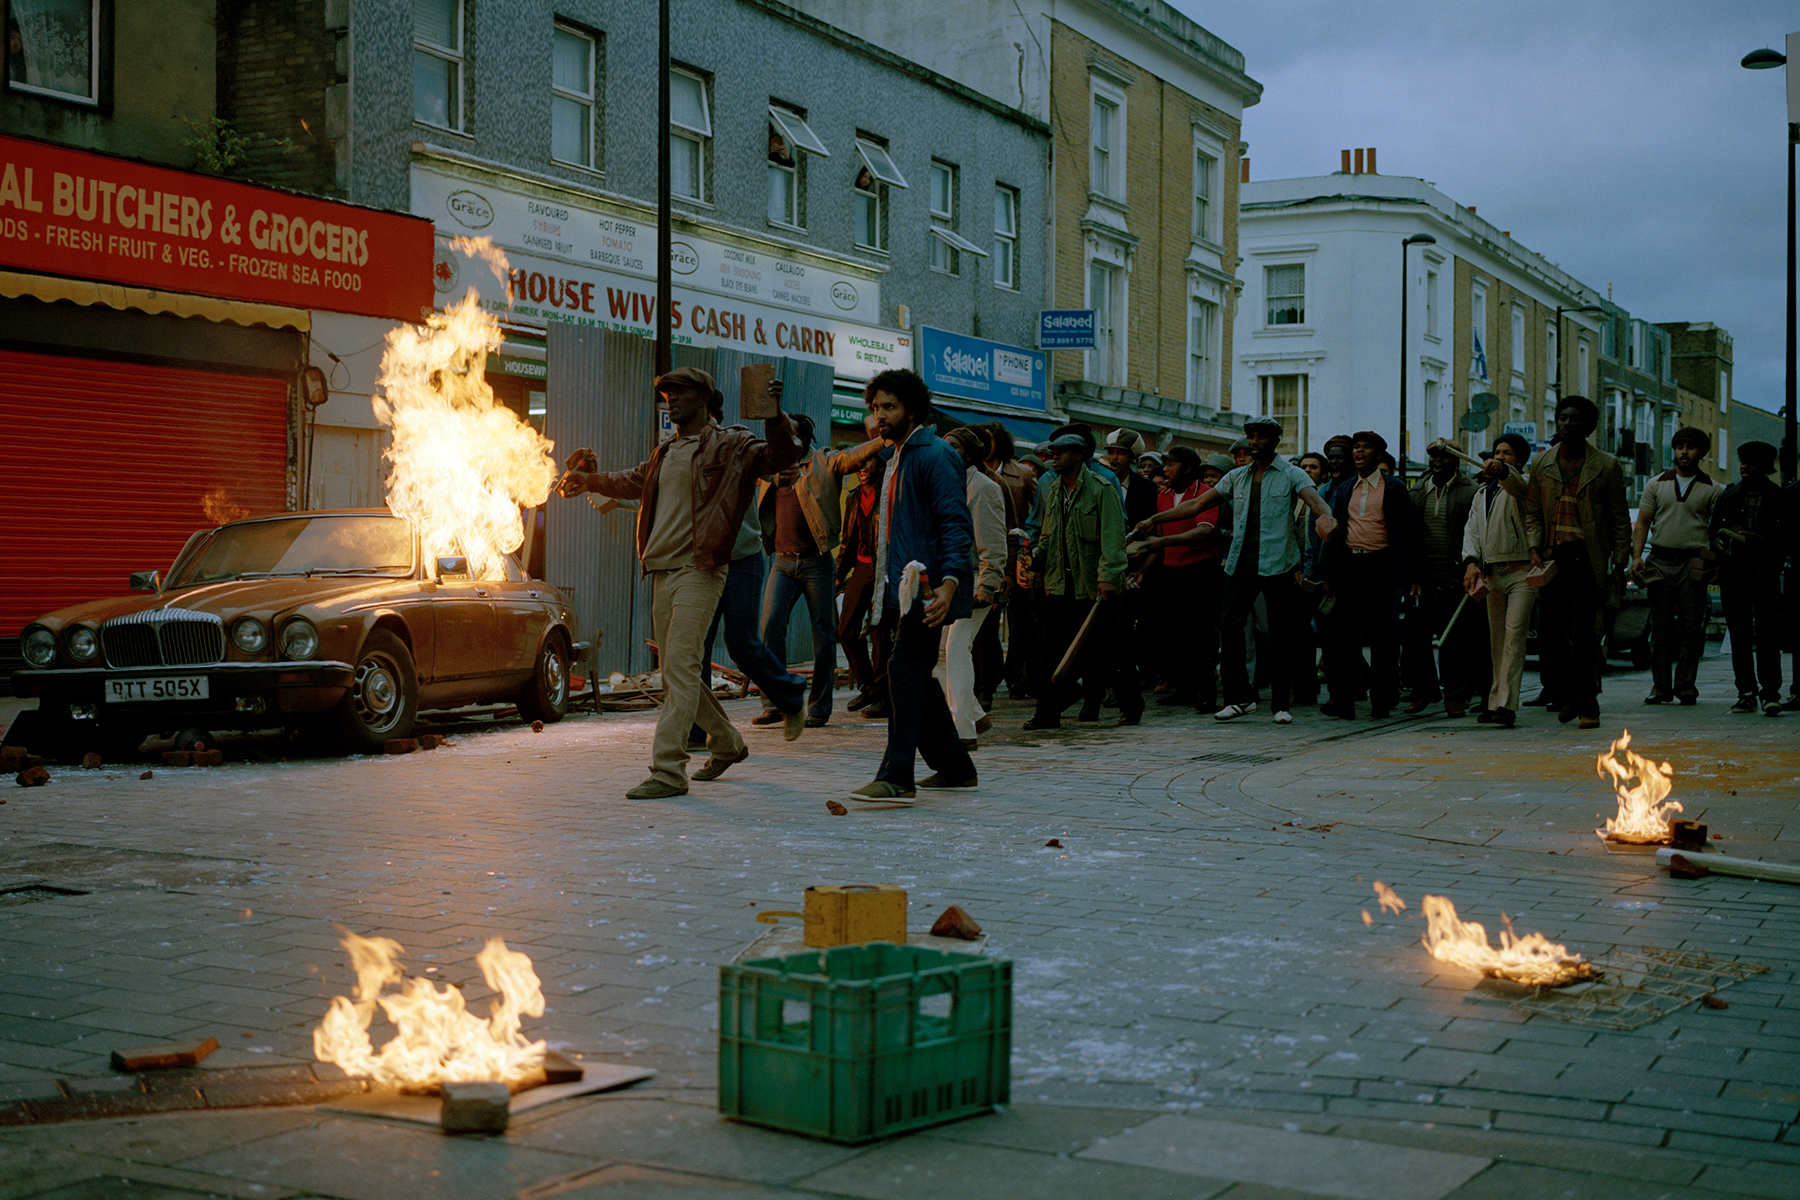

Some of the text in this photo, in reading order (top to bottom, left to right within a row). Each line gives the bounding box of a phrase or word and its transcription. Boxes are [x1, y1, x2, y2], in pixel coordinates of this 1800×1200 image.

[0, 162, 369, 267] AL BUTCHERS & GROCERS
[451, 198, 490, 219] Grace
[528, 201, 569, 221] FLAVOURED
[599, 219, 636, 237] HOT PEPPER
[602, 236, 633, 252] TOMATO
[46, 224, 103, 252] FRESH
[108, 234, 157, 260] FRUIT
[161, 243, 172, 264] &
[178, 246, 213, 269] VEG.
[229, 253, 288, 280] FROZEN
[292, 262, 320, 286] SEA
[324, 269, 362, 292] FOOD
[590, 249, 643, 270] BARBEQUE SAUCES
[723, 248, 744, 263] COCONUT
[775, 261, 805, 277] CALLALOO
[721, 278, 734, 289] BLACK
[832, 287, 856, 303] Grace
[508, 267, 836, 358] HOUSE WIVS CASH & CARRY
[1043, 314, 1093, 329] Salabed
[629, 325, 654, 338] SUNDAY
[848, 335, 894, 353] WHOLESALE
[897, 337, 910, 347] 103
[856, 350, 889, 365] & RETAIL
[943, 345, 989, 381] Salabed
[1003, 354, 1029, 371] PHONE
[831, 409, 839, 419] SH
[153, 679, 202, 697] 505X
